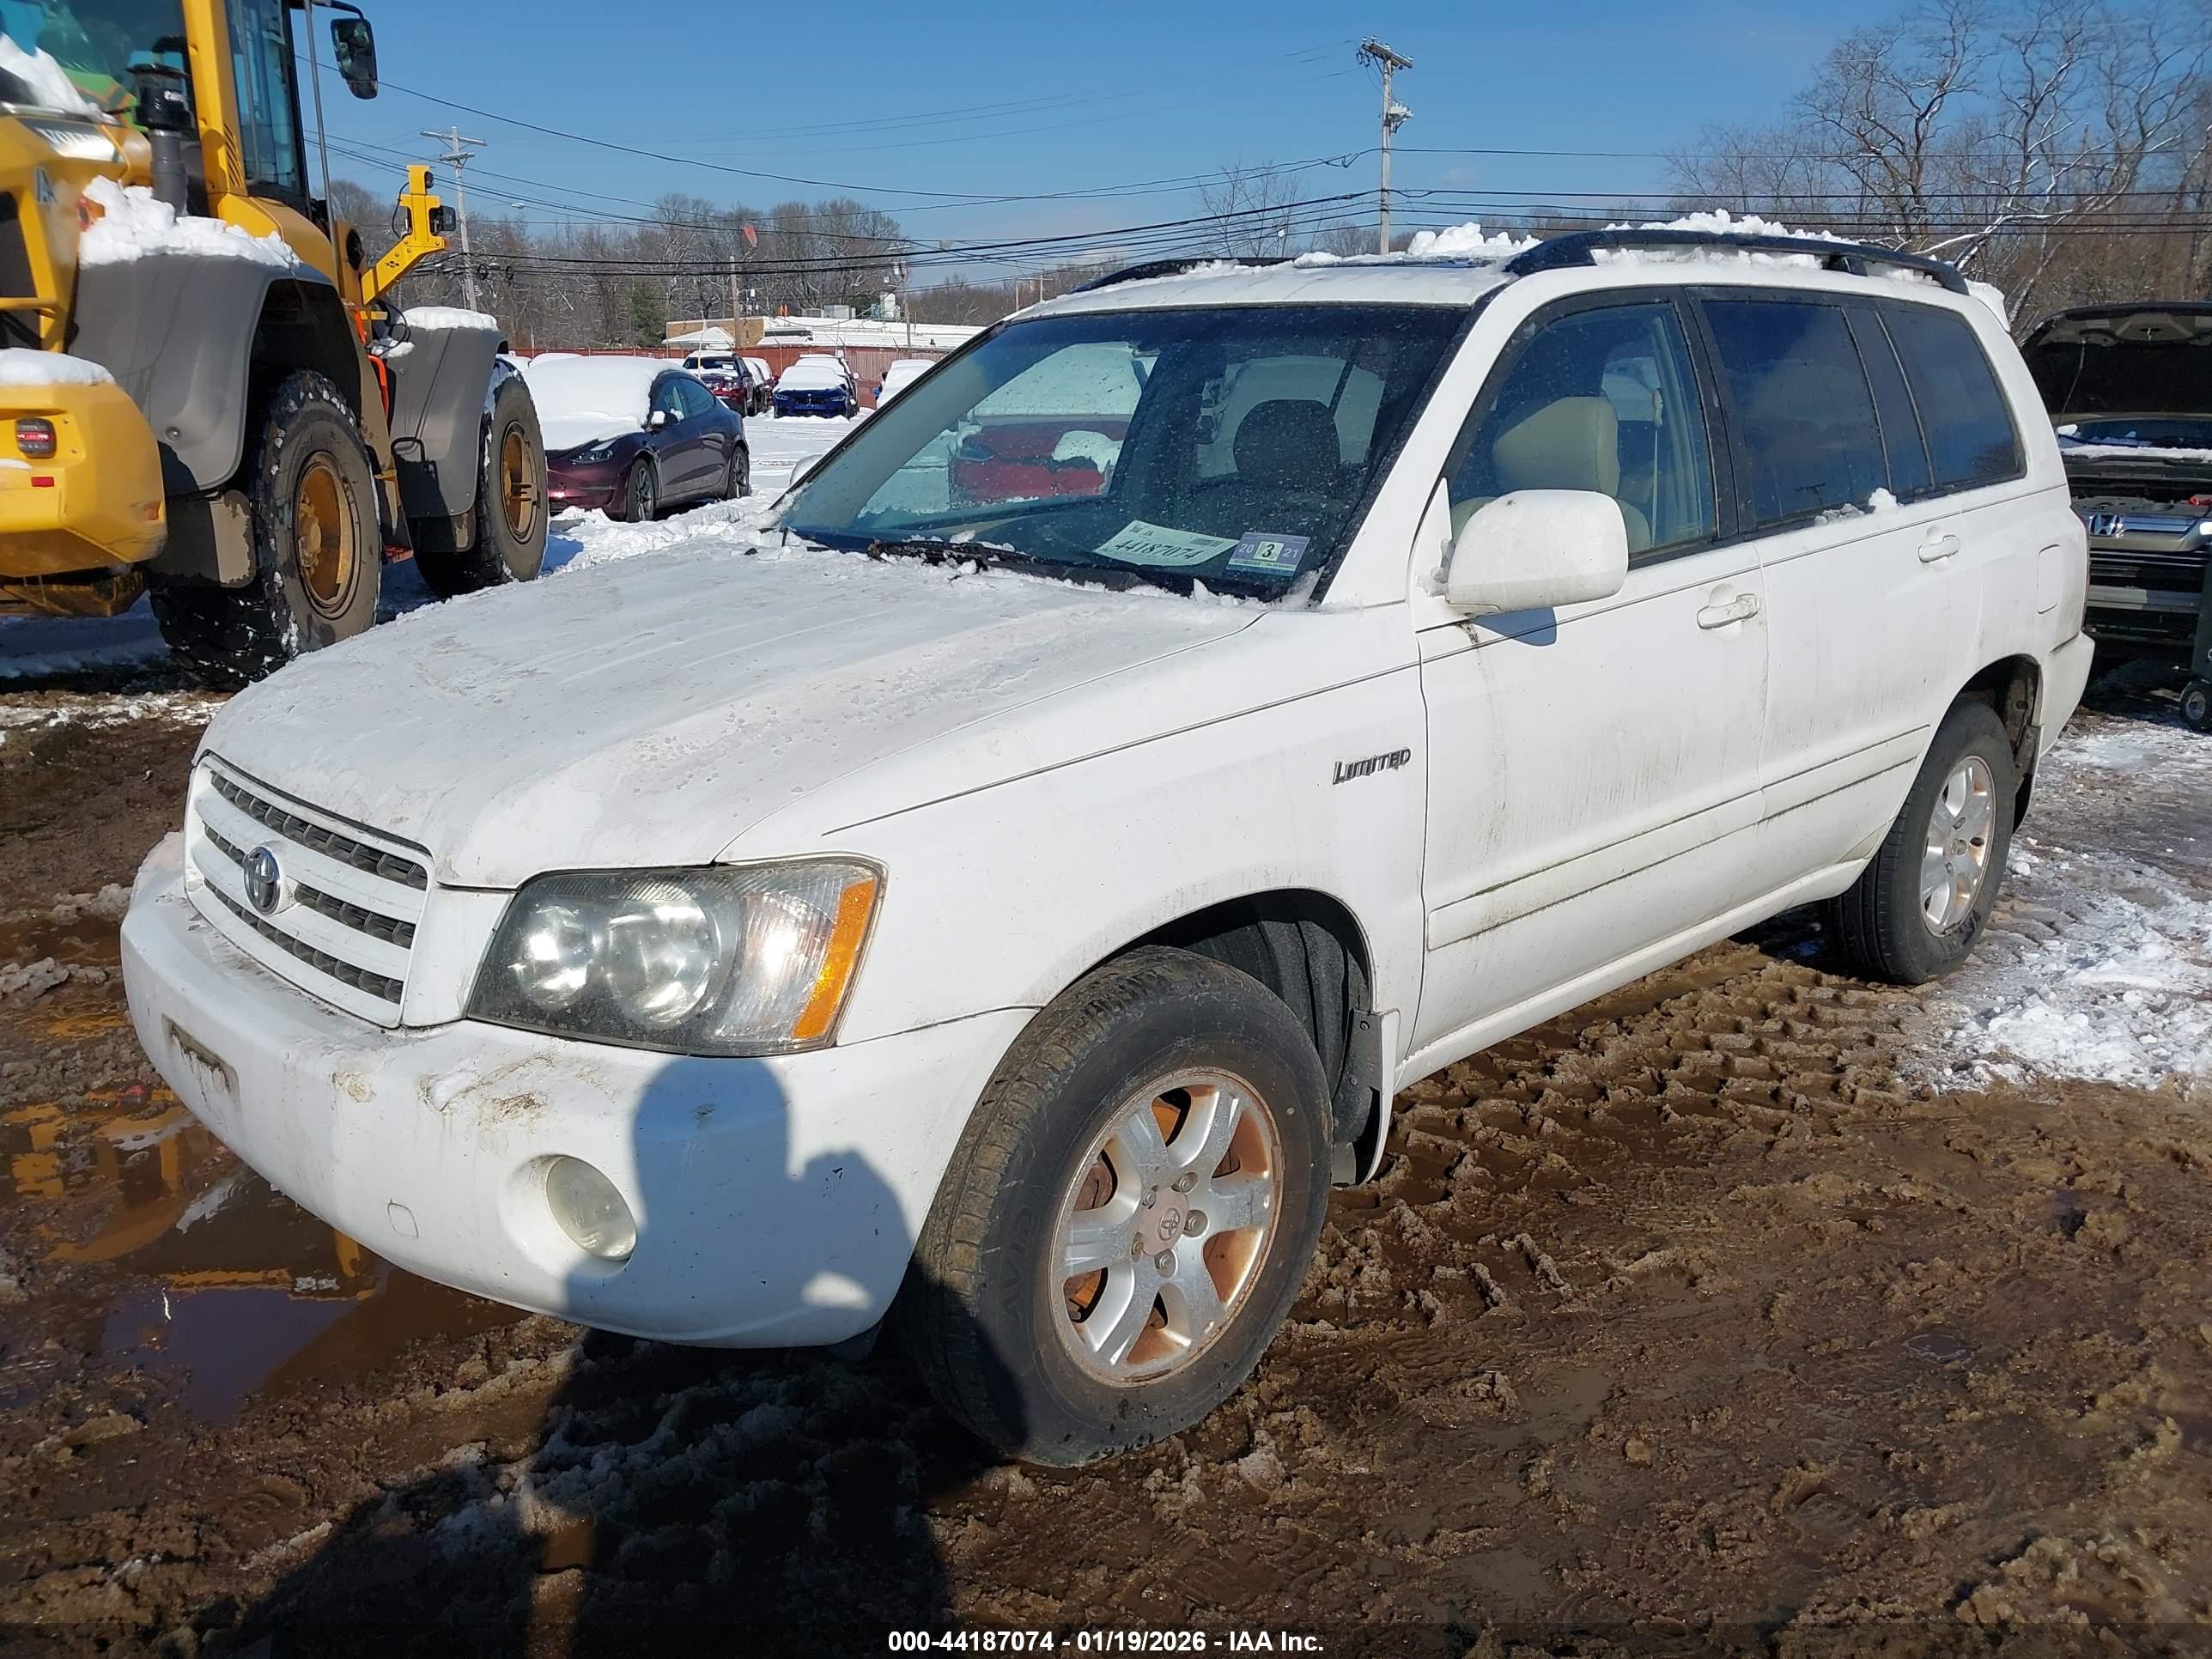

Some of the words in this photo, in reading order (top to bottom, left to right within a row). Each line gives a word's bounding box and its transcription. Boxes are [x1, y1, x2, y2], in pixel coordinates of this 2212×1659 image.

[1115, 539, 1204, 559] 44187074
[1238, 543, 1255, 554] 20
[1261, 544, 1275, 558] 3
[1282, 548, 1299, 558] 21
